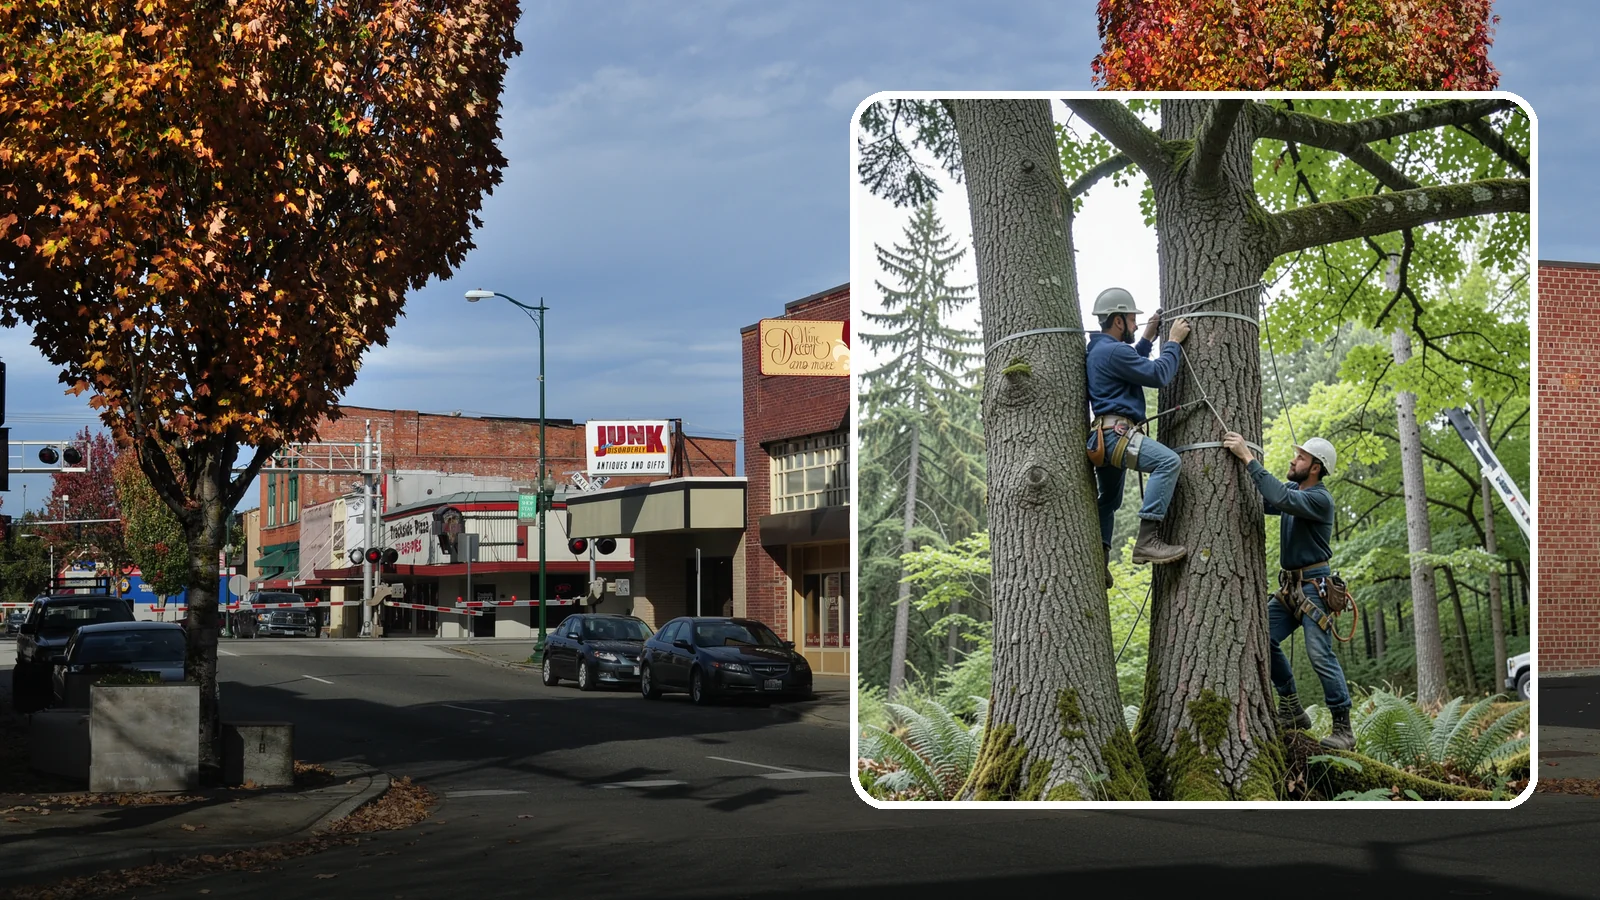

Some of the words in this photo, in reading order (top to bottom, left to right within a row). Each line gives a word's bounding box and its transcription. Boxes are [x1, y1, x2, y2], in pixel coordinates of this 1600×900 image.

[595, 425, 665, 457] JUNK
[607, 446, 646, 454] DISORDERLY
[597, 461, 628, 470] ANTIQUES
[631, 461, 644, 470] AND
[647, 460, 665, 470] GIFTS
[414, 519, 429, 535] Pizza
